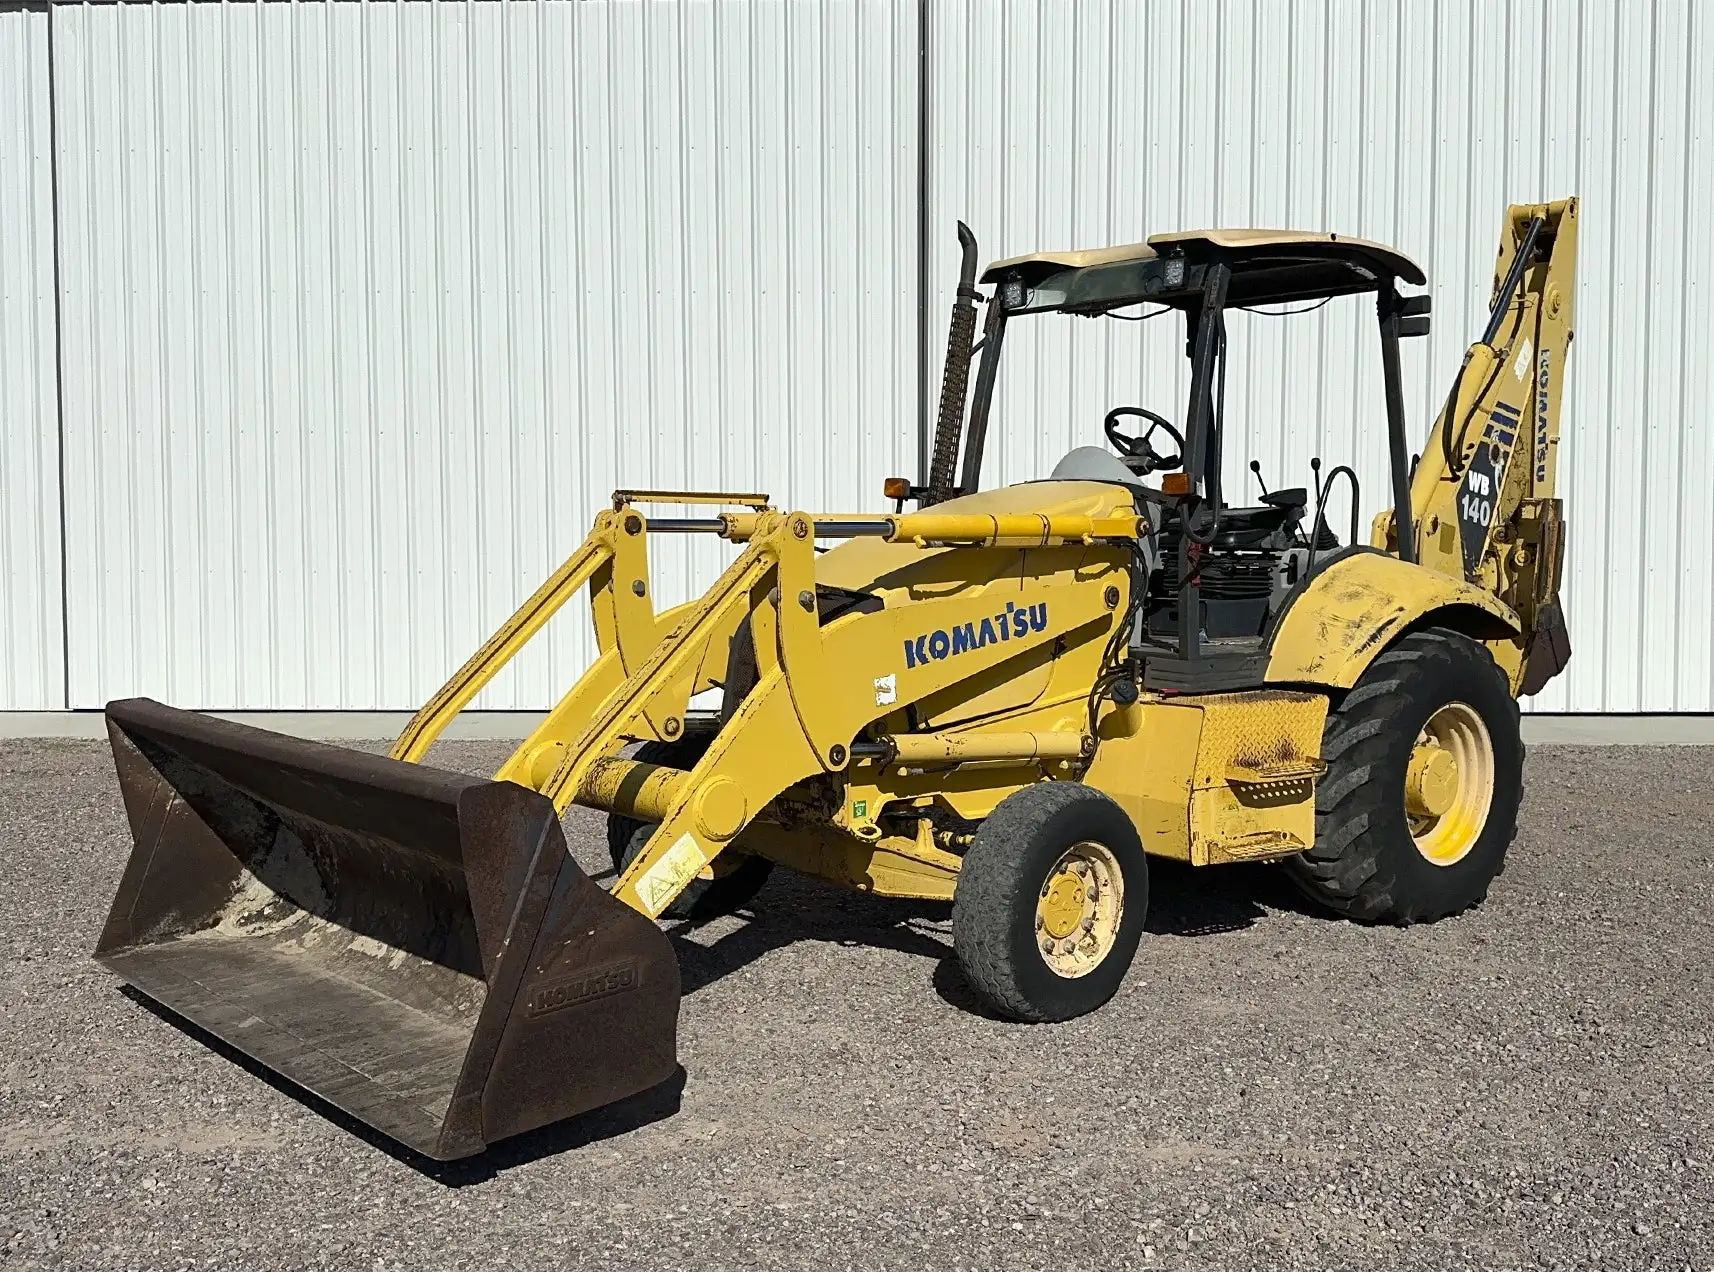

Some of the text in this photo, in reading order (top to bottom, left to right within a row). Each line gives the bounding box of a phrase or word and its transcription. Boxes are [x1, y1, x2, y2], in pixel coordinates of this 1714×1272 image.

[1536, 349, 1549, 482] KOMATSU
[1468, 469, 1490, 496] WB
[1461, 494, 1491, 527] 140
[904, 601, 1048, 669] KOMATSU
[536, 967, 633, 1010] KOMATSU
